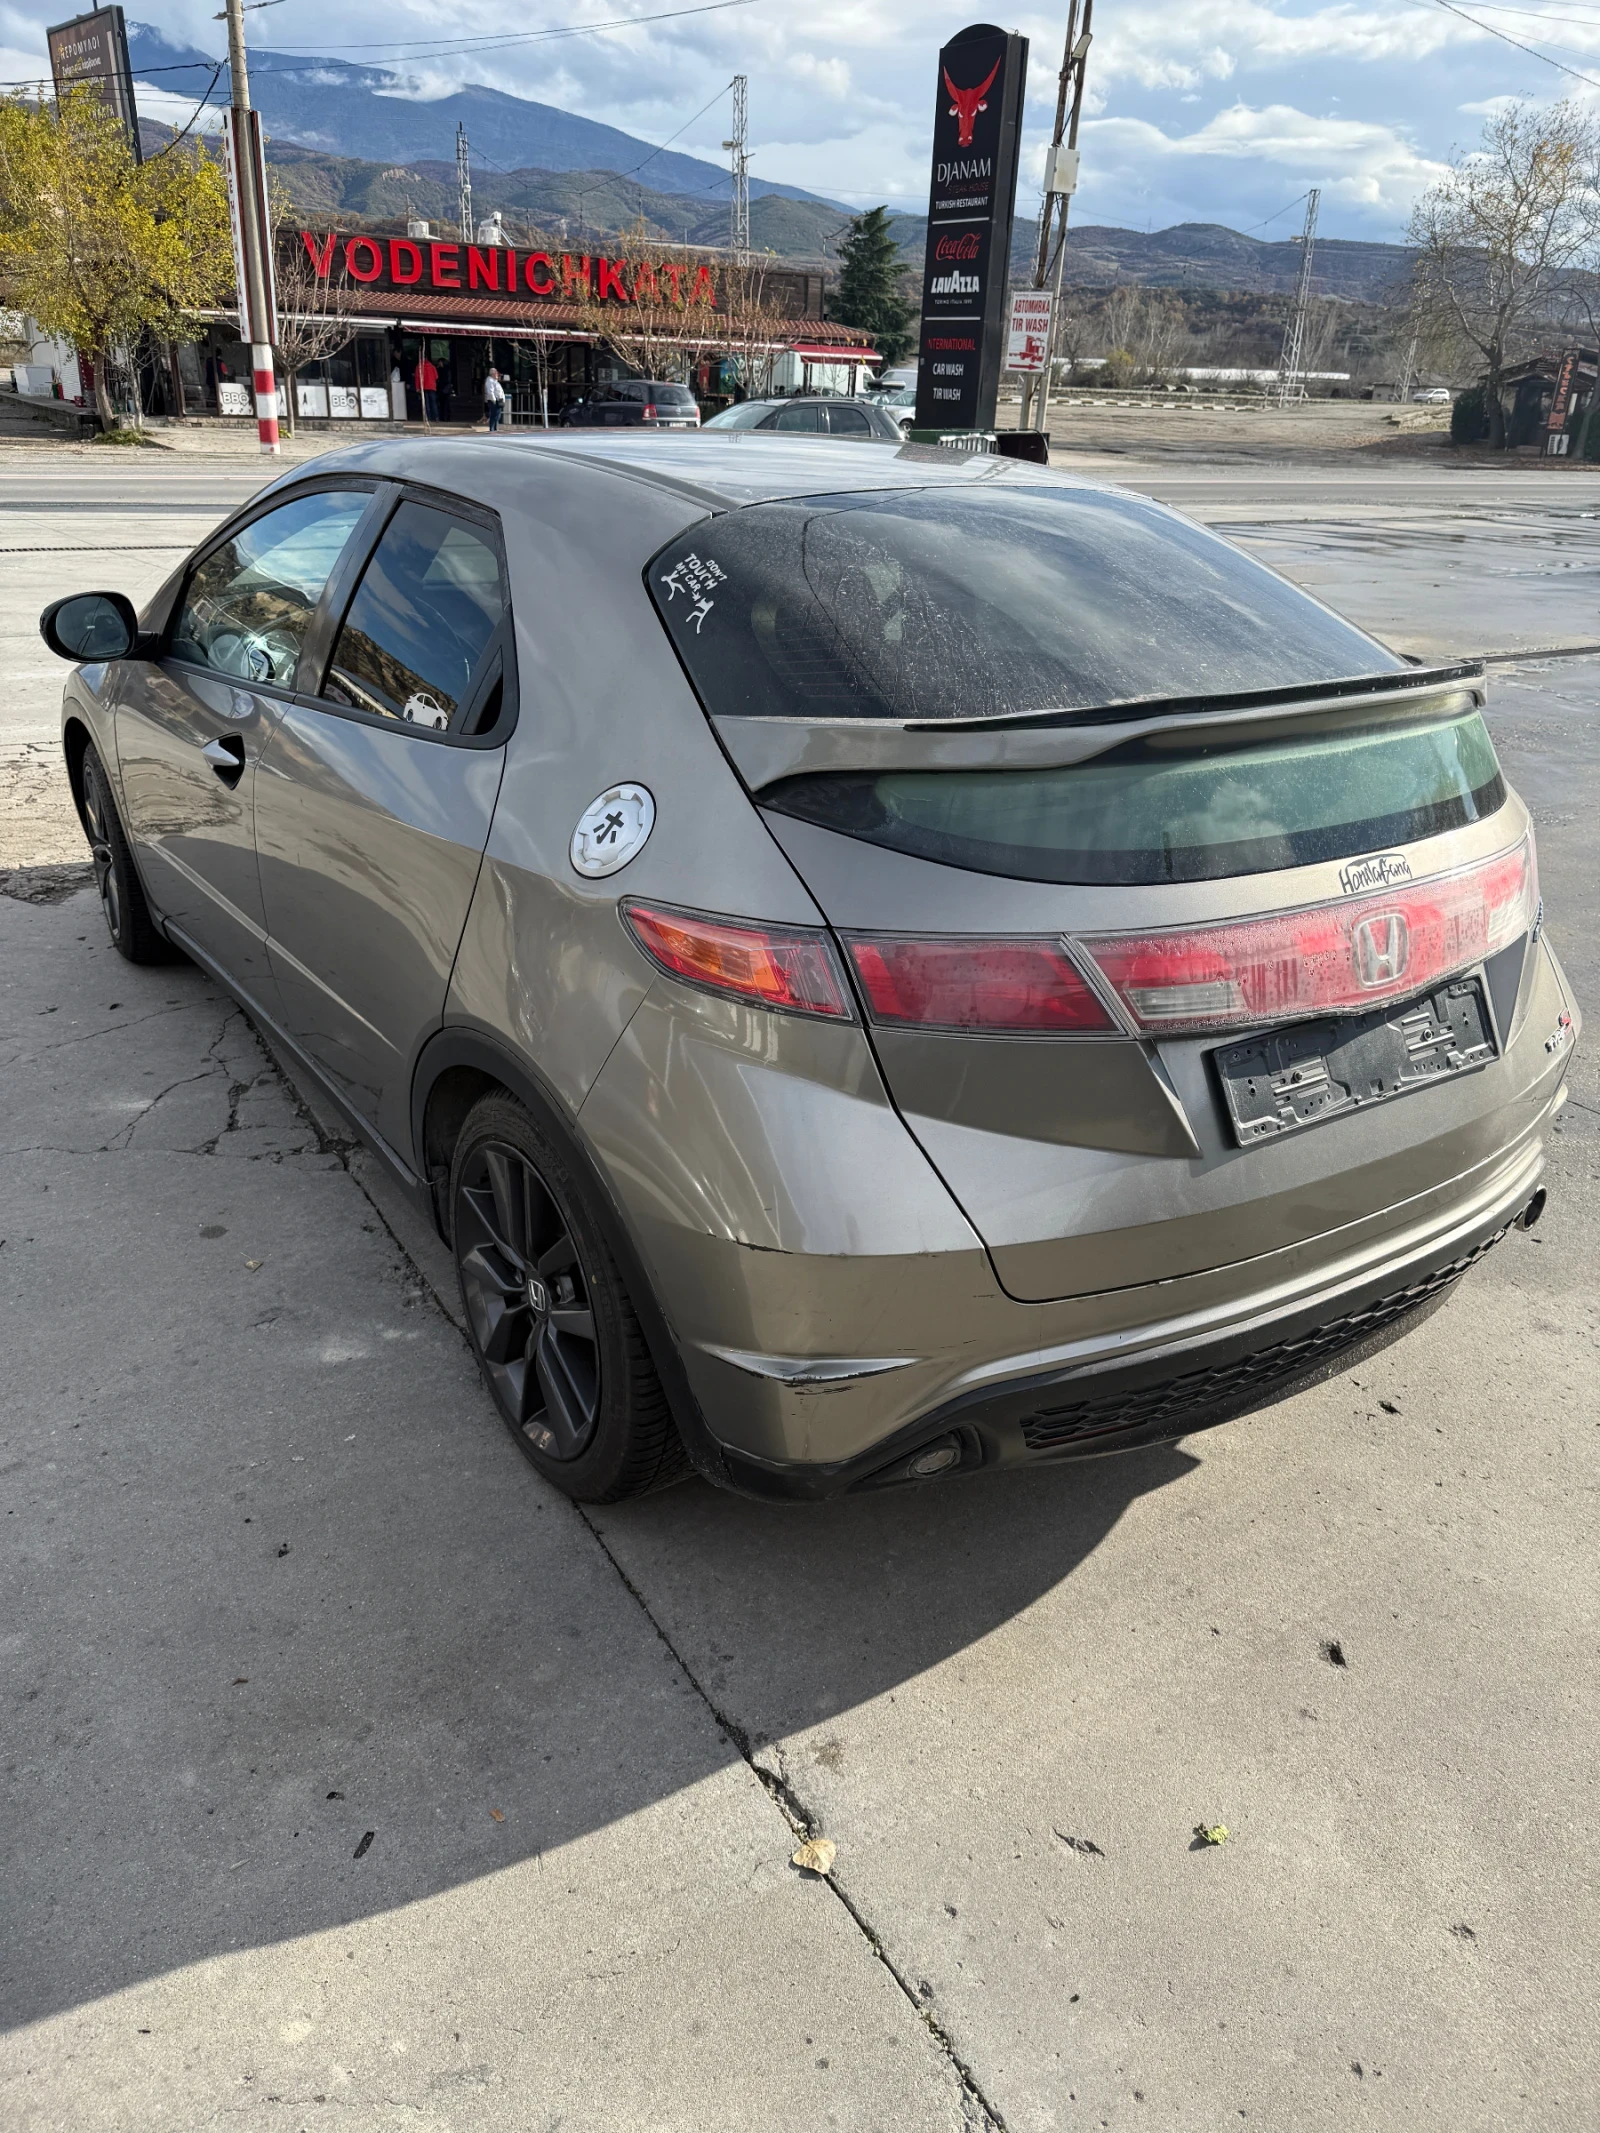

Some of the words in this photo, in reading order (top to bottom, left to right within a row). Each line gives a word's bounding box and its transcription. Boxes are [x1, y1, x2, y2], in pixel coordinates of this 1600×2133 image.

[937, 157, 991, 188] DJANAM
[935, 199, 956, 210] TURKISH
[956, 196, 988, 208] RESTAURANT
[301, 231, 717, 306] VODENICHKATA
[930, 270, 980, 294] LAVAZZA
[1013, 299, 1050, 314] АВТОМИВКА
[1012, 318, 1024, 332] TIR
[1025, 318, 1049, 333] WASH
[932, 363, 946, 375] CAR
[945, 363, 964, 376] WASH
[222, 391, 249, 407] BBQ
[332, 394, 358, 409] BBQ
[932, 387, 943, 400] TIR
[943, 388, 961, 400] WASH
[675, 561, 689, 575] MY
[684, 574, 701, 592] CAR
[684, 552, 718, 590] TOUCH
[706, 559, 728, 581] DON'T
